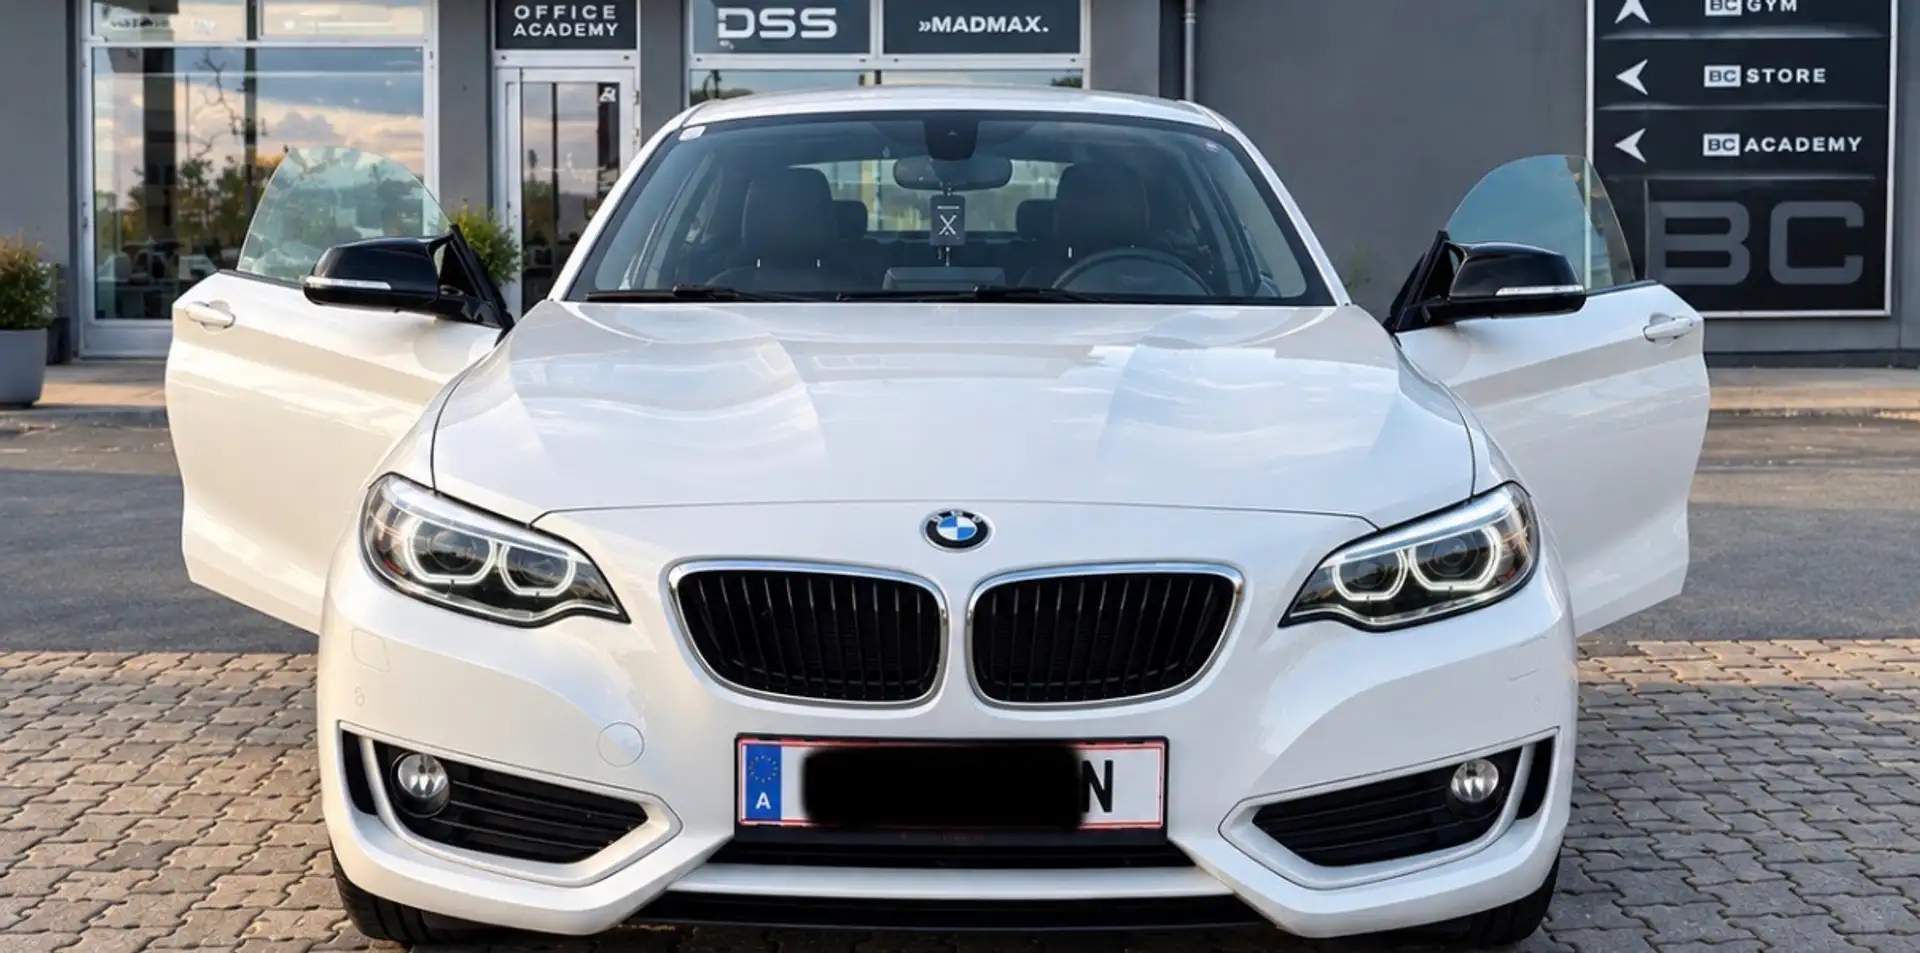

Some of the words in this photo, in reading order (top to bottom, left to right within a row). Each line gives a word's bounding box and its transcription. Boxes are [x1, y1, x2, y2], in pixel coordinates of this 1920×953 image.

[514, 5, 616, 20] OFFICE
[1708, 0, 1739, 12] BC
[1746, 0, 1798, 12] GYM
[513, 22, 619, 37] ACADEMY
[718, 8, 837, 38] DSS
[1707, 69, 1738, 83] BC
[1746, 68, 1827, 83] STORE
[1706, 138, 1737, 152] BC
[1744, 136, 1862, 152] ACADEMY
[1647, 201, 1865, 285] BC
[756, 792, 771, 809] A
